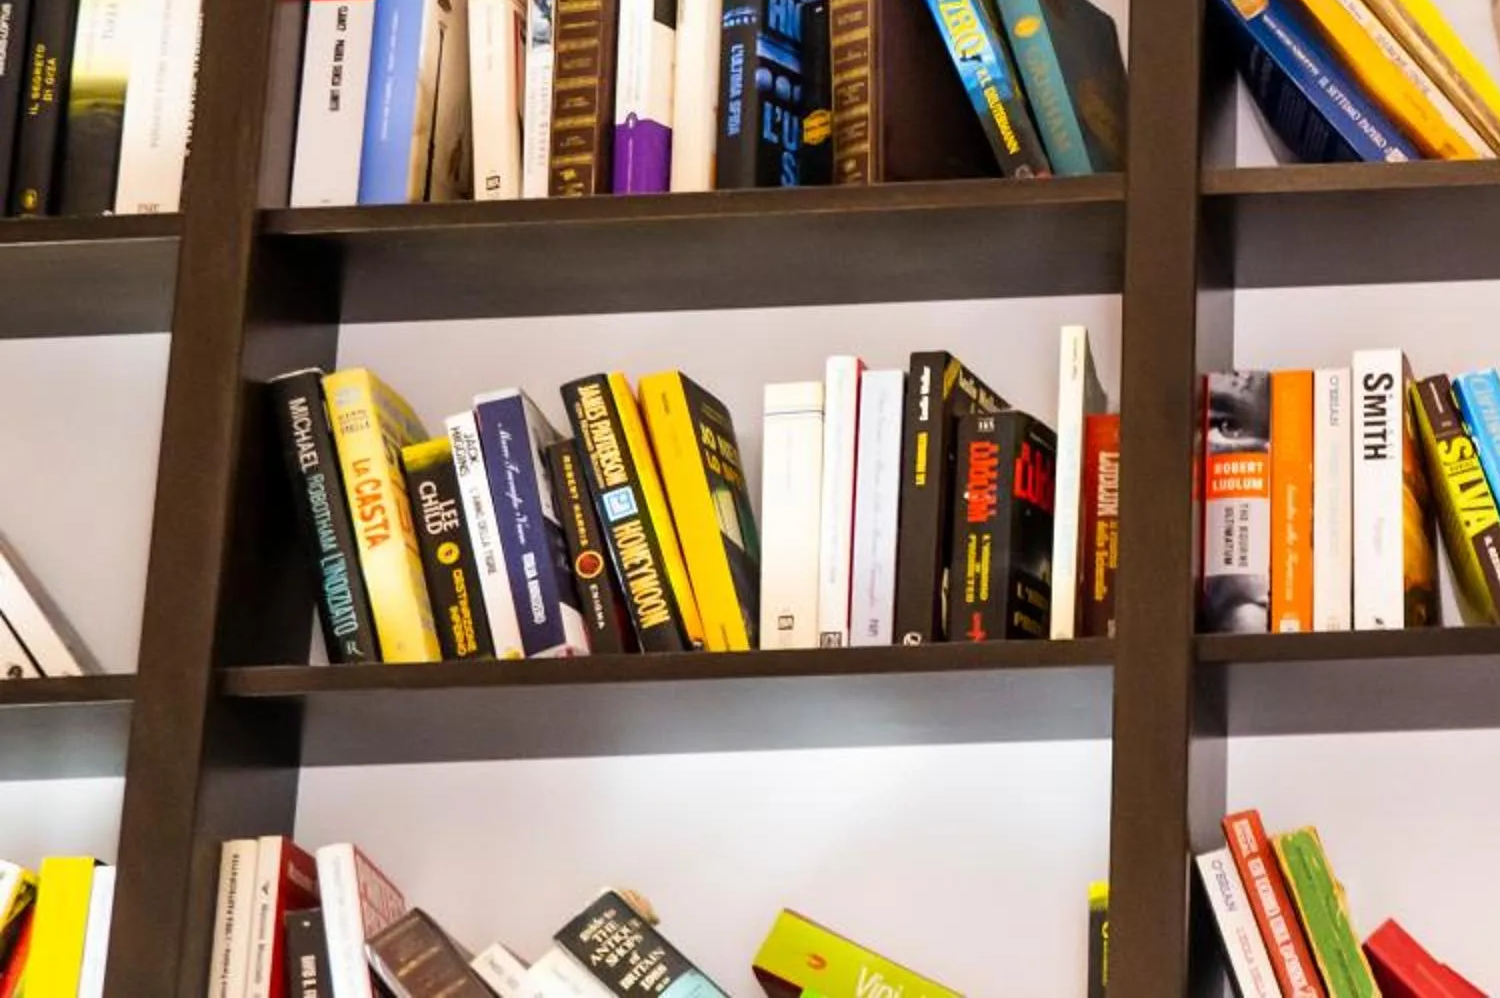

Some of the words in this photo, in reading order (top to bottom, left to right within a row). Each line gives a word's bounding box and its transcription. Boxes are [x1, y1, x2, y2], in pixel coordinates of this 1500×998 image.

[287, 396, 323, 474] MICHAEL
[465, 432, 479, 465] JACK
[1362, 372, 1395, 461] SMITH
[304, 472, 337, 553] ROBOTHAM
[354, 477, 391, 550] CASTA
[417, 480, 444, 535] CHILD
[438, 499, 460, 533] LEE
[1097, 450, 1120, 517] LUDLUM
[1436, 434, 1500, 539] SILVA
[319, 552, 359, 637] L'INDIZIATO
[611, 518, 671, 630] HONEYMOON
